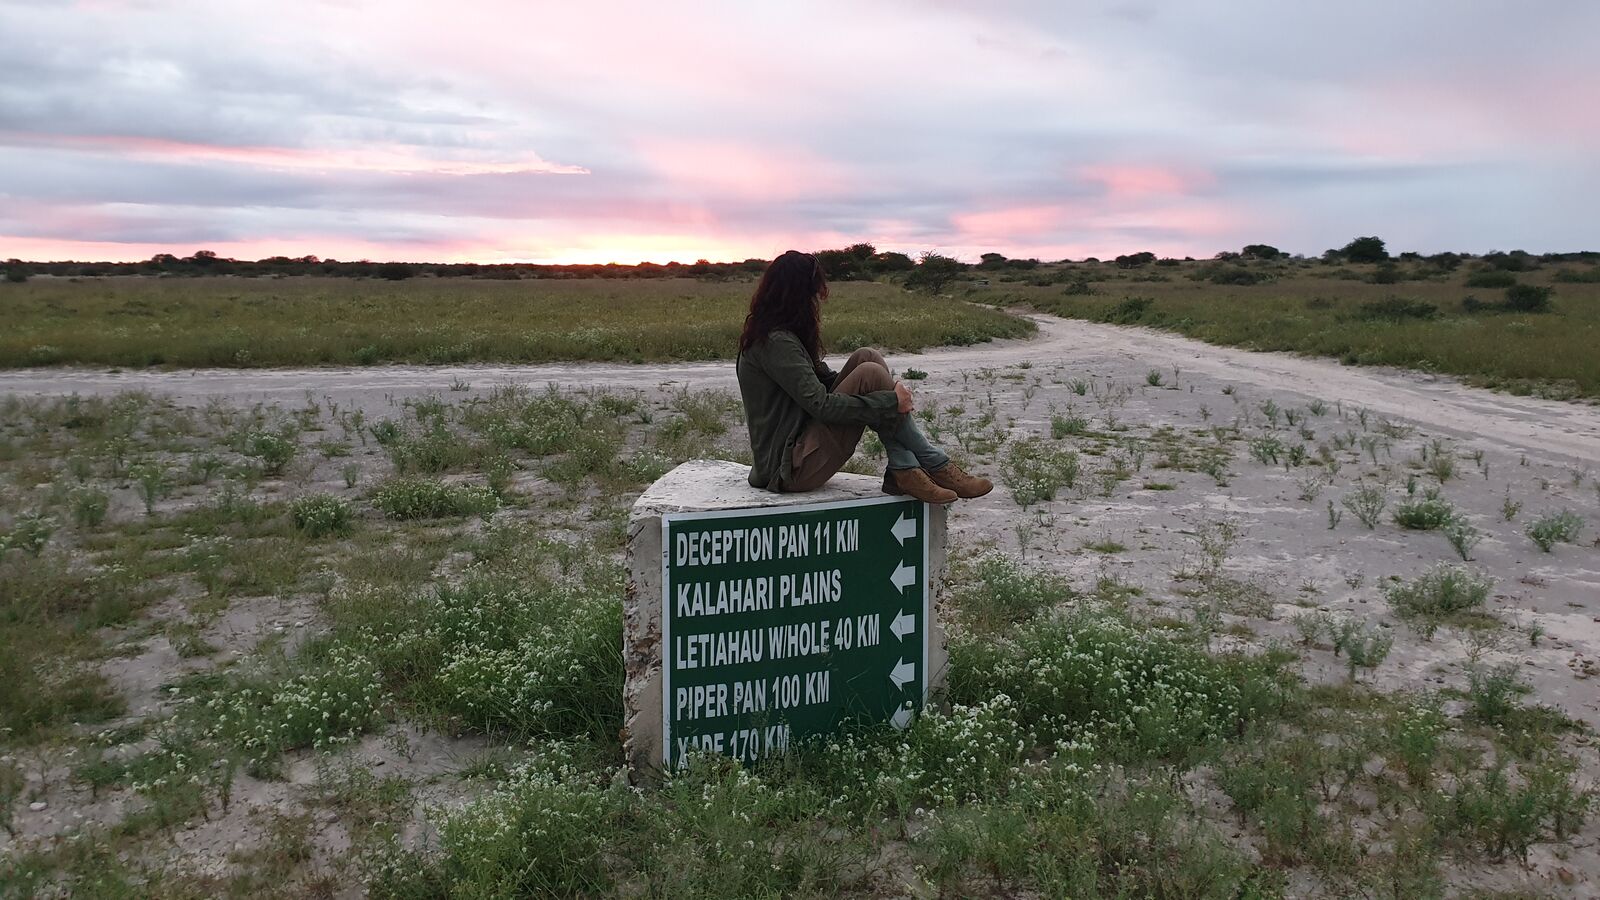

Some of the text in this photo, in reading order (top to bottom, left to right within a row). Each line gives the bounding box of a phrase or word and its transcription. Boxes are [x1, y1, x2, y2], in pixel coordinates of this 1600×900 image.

[676, 519, 859, 567] DECEPTION PAN 11 KM
[677, 569, 842, 617] KALAHARI PLAINS
[676, 613, 880, 670] LETIAHAU W/HOLE 40 KM
[676, 671, 830, 721] PIPER PAN 100 KM
[730, 728, 759, 762] 170
[764, 724, 790, 759] KM
